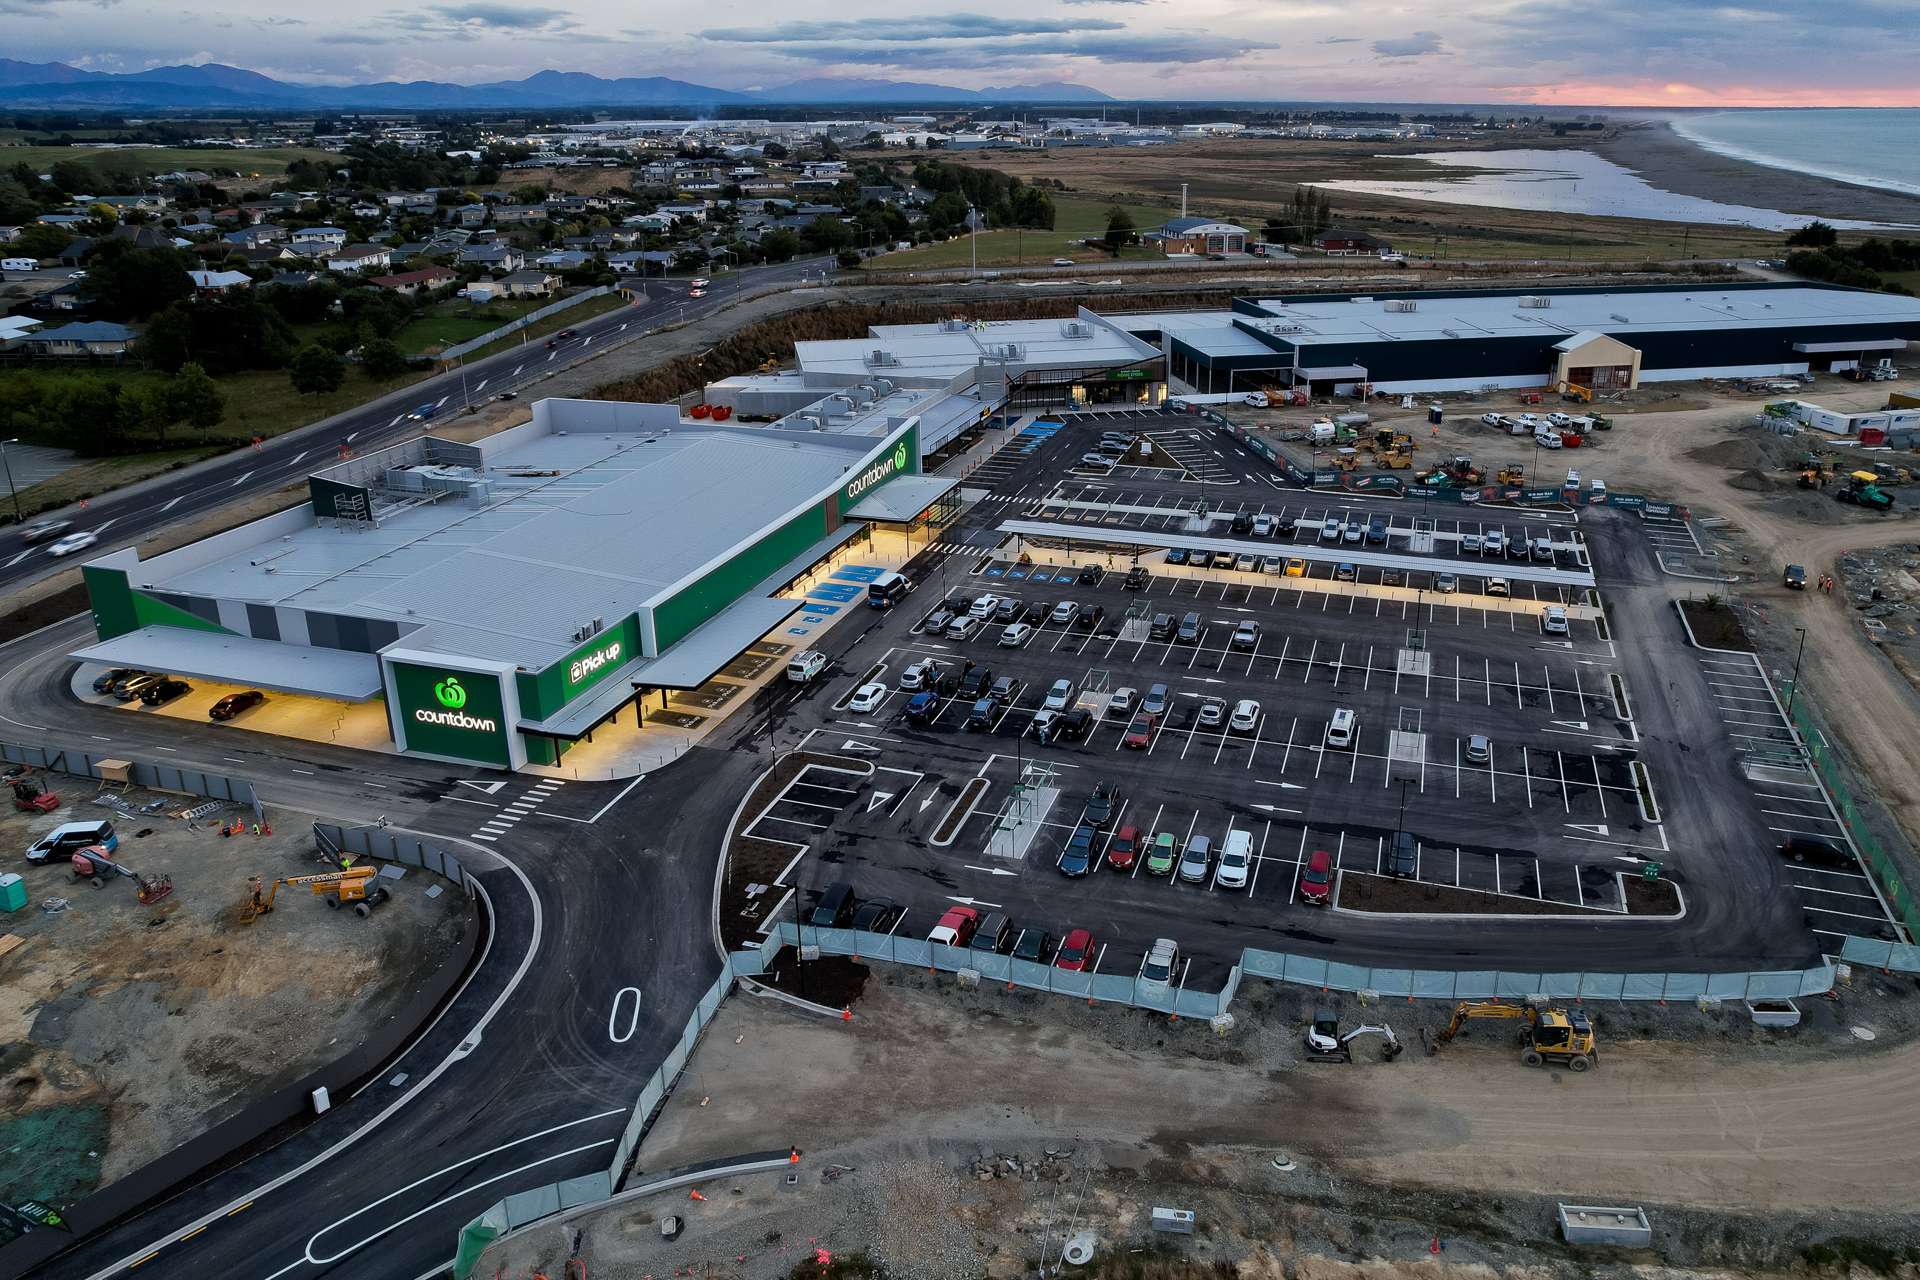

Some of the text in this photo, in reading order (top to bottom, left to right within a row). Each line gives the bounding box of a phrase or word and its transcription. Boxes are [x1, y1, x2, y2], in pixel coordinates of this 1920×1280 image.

[848, 458, 894, 498] countdown
[581, 643, 620, 676] Pick up
[415, 709, 496, 732] countdown
